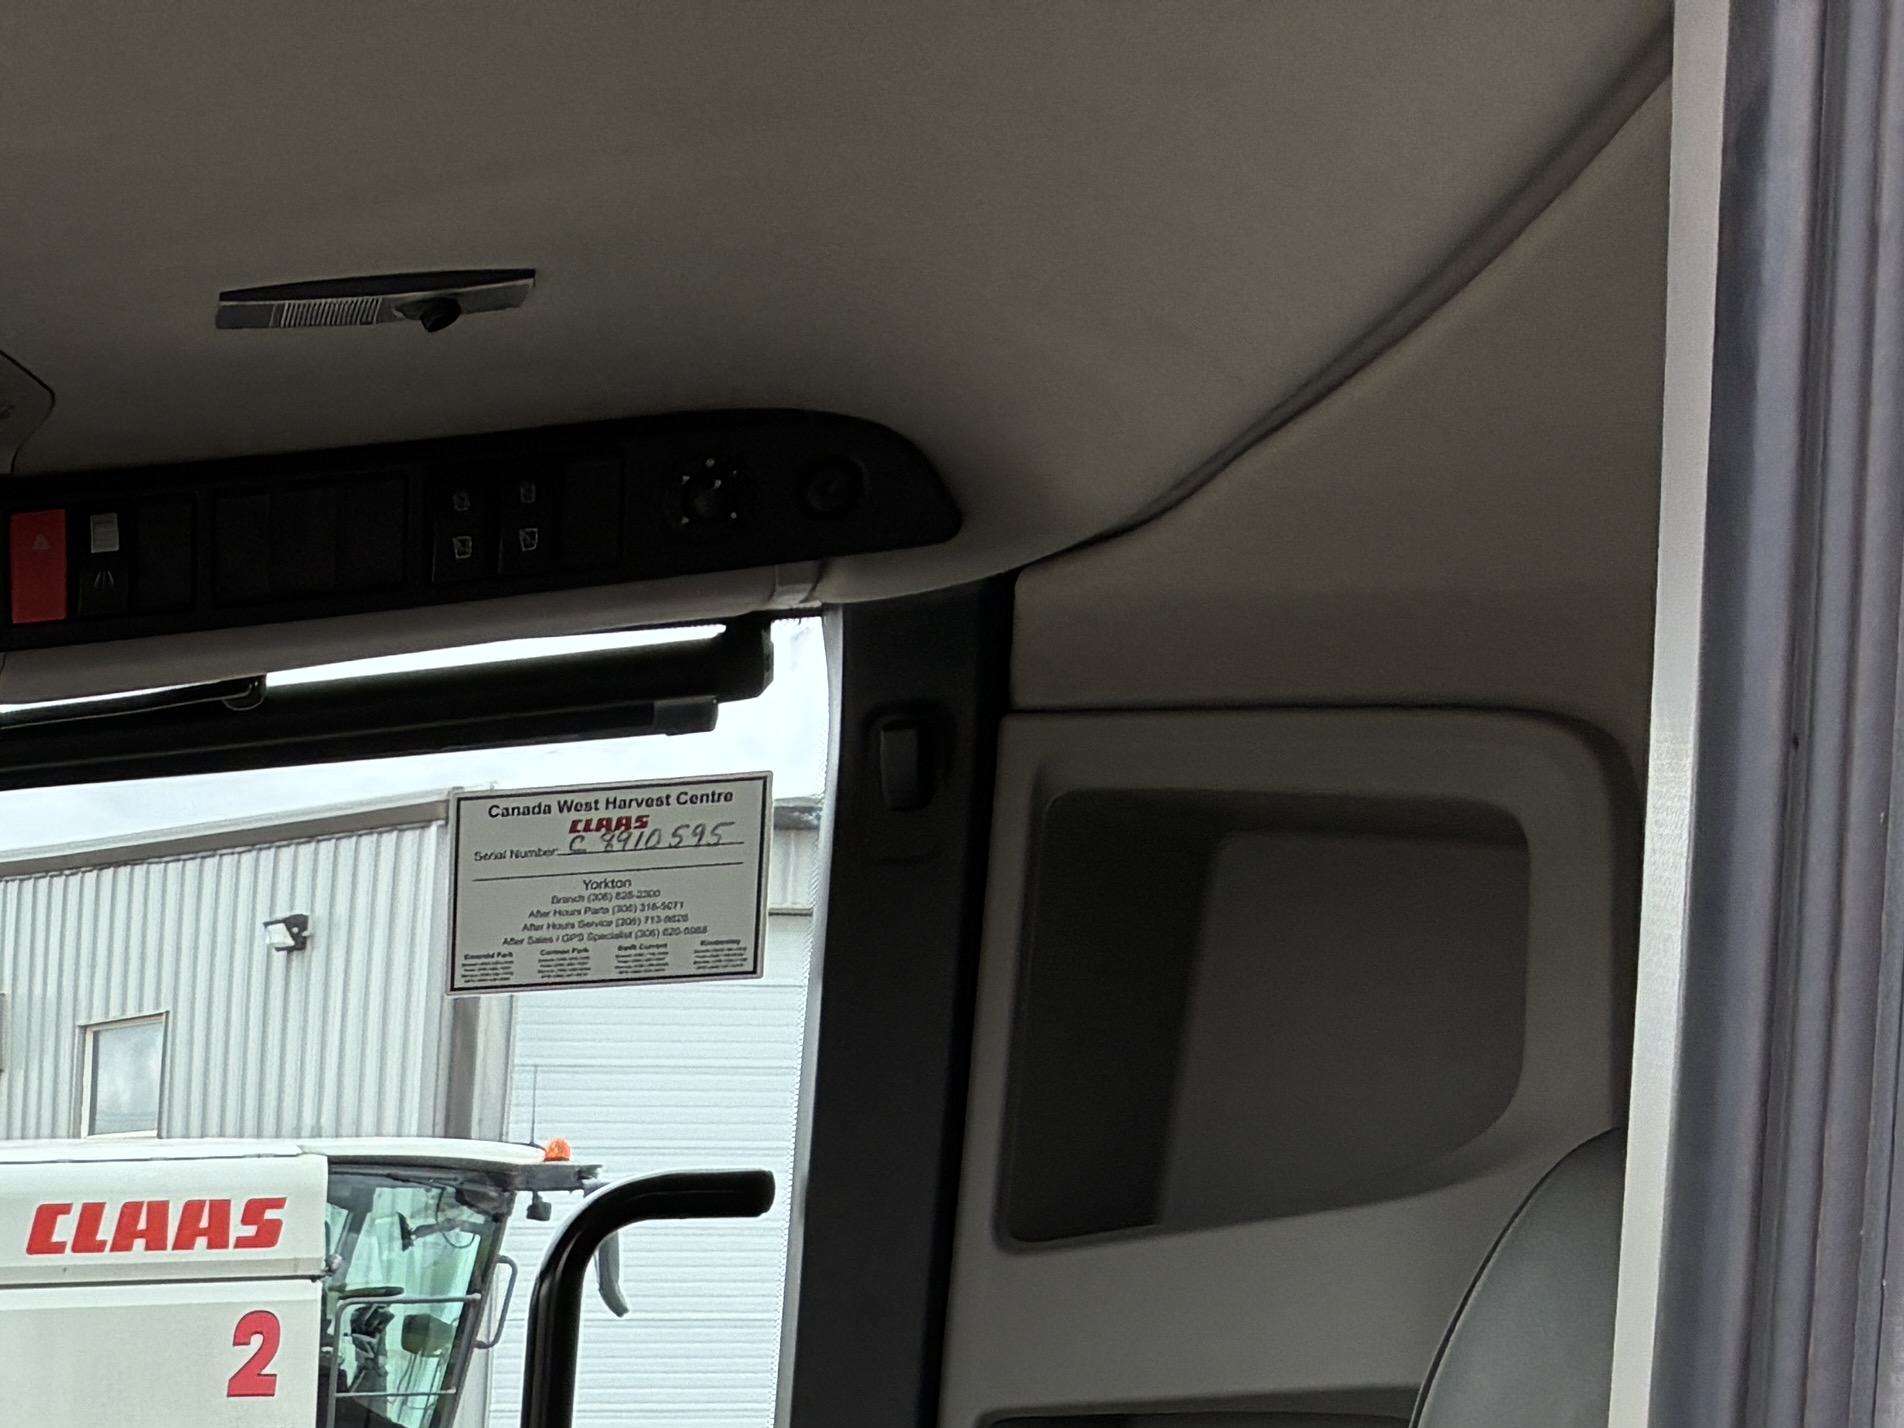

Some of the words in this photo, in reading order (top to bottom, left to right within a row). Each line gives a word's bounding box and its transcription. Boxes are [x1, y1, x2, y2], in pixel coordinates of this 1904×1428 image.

[488, 802, 552, 818] Canada
[557, 799, 601, 814] West
[605, 793, 672, 811] Harvest
[676, 789, 734, 806] Centre
[569, 814, 651, 834] CLAAS
[583, 878, 632, 891] Yorkton
[26, 1197, 288, 1256] CLAAS
[226, 1309, 281, 1399] 2
